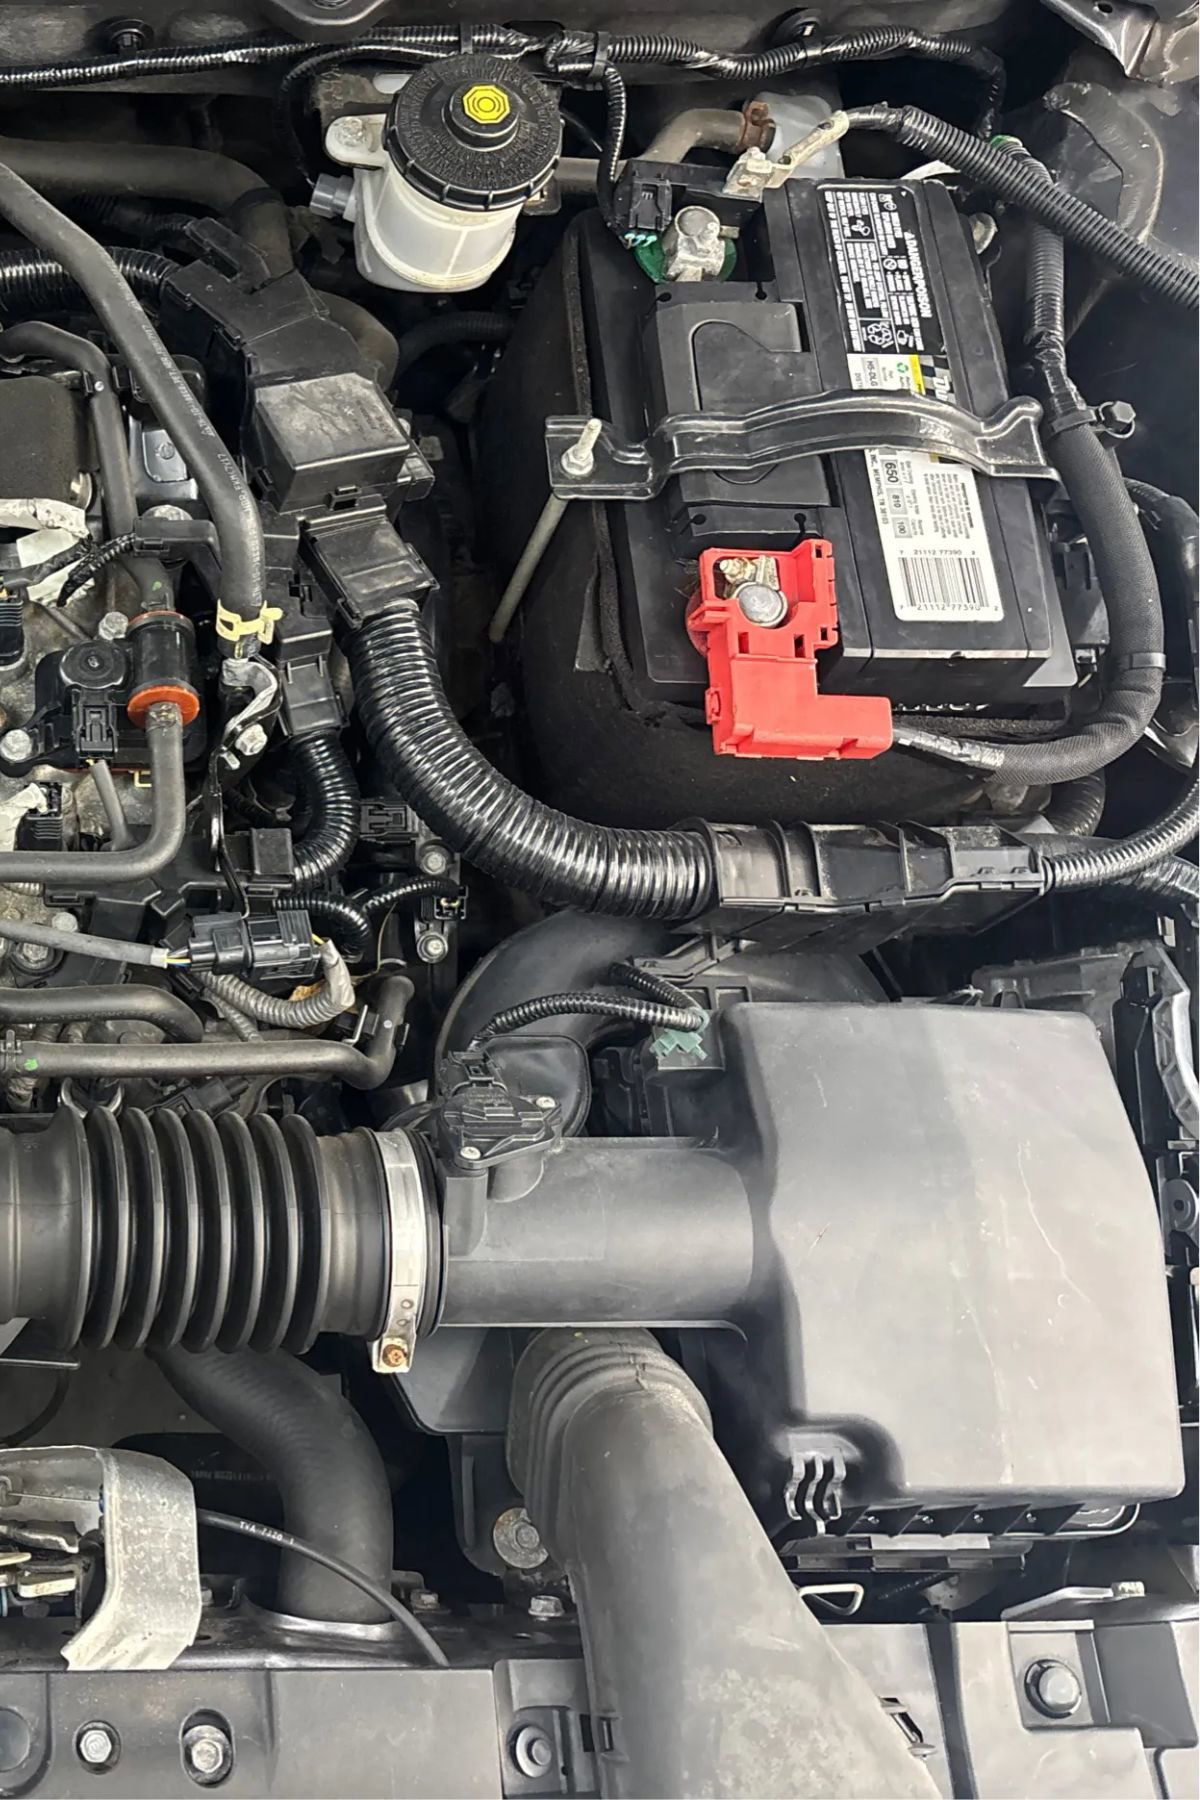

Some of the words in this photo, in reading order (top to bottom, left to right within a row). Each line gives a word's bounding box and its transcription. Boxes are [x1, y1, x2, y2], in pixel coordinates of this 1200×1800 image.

[885, 462, 898, 483] 650
[892, 494, 902, 508] 810
[897, 521, 906, 534] 100
